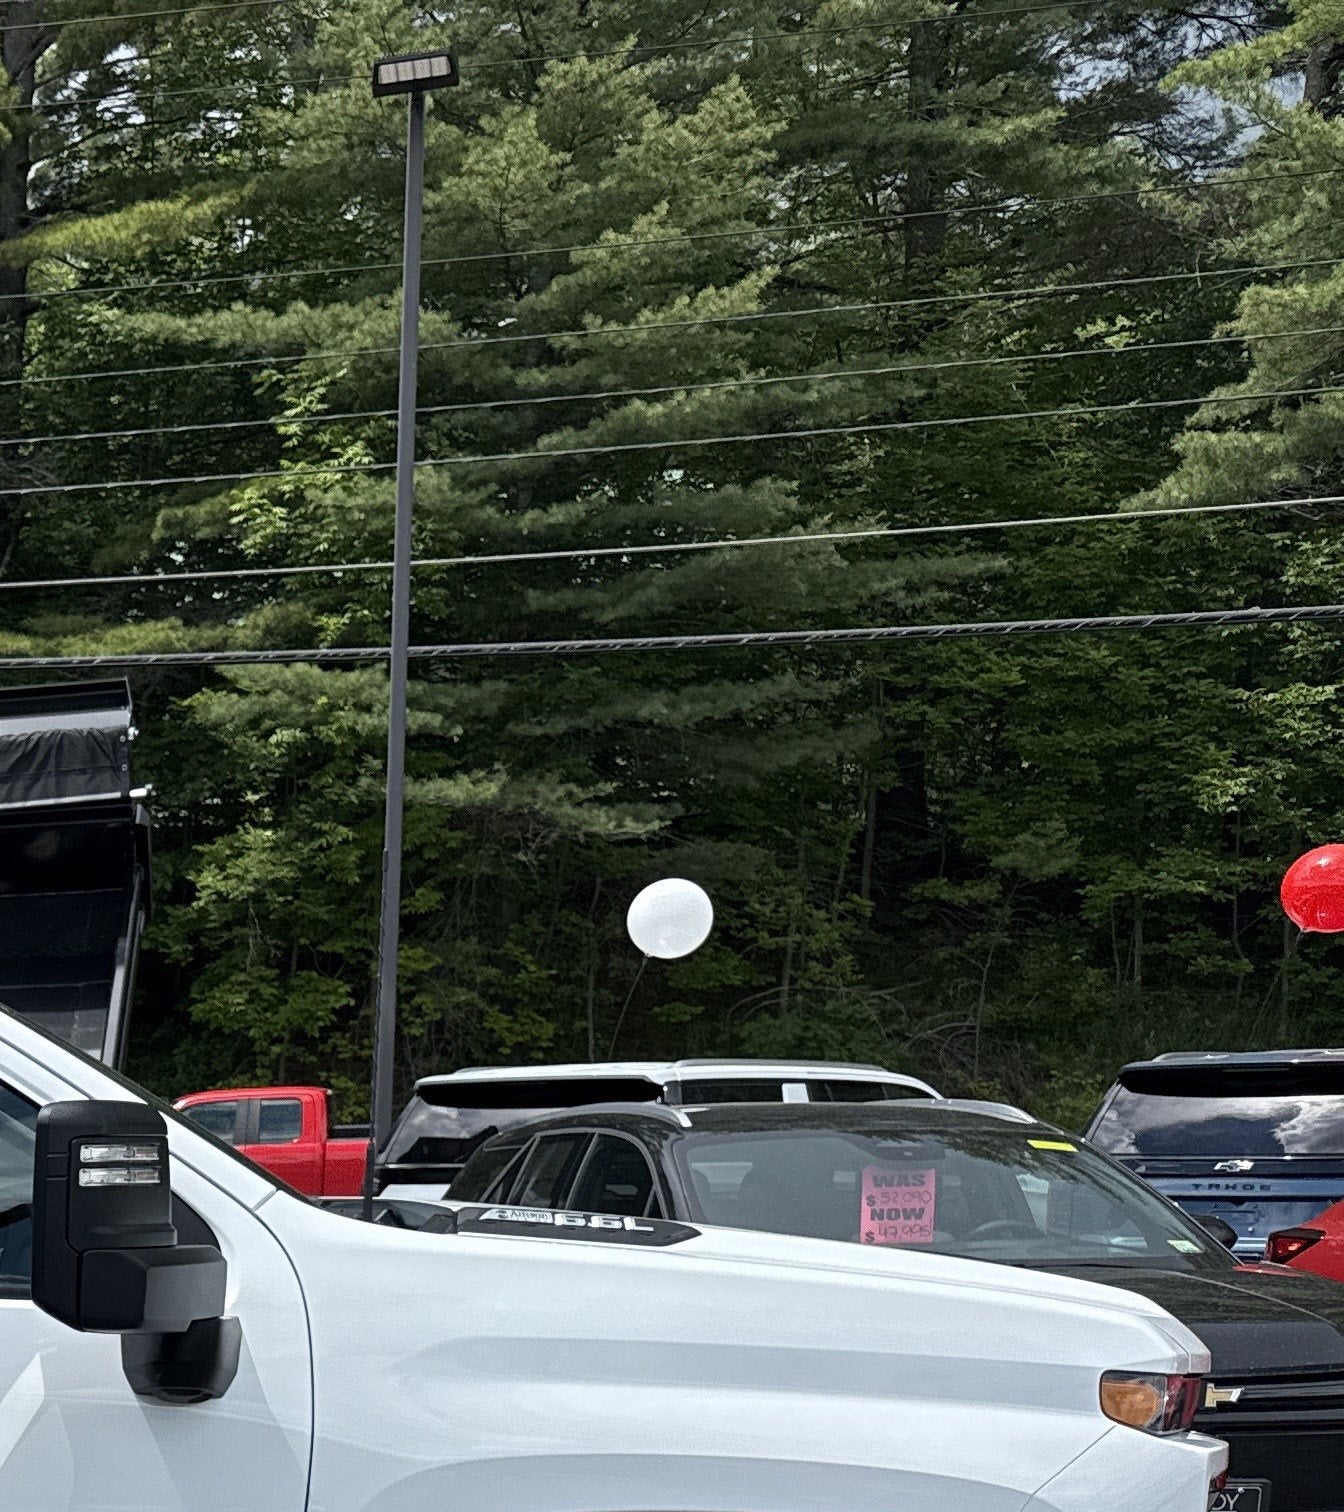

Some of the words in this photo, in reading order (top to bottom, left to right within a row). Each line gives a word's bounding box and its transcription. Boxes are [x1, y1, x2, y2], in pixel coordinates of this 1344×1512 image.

[873, 1173, 926, 1188] WAS
[870, 1208, 926, 1221] NOW
[553, 1213, 655, 1232] 6.6L
